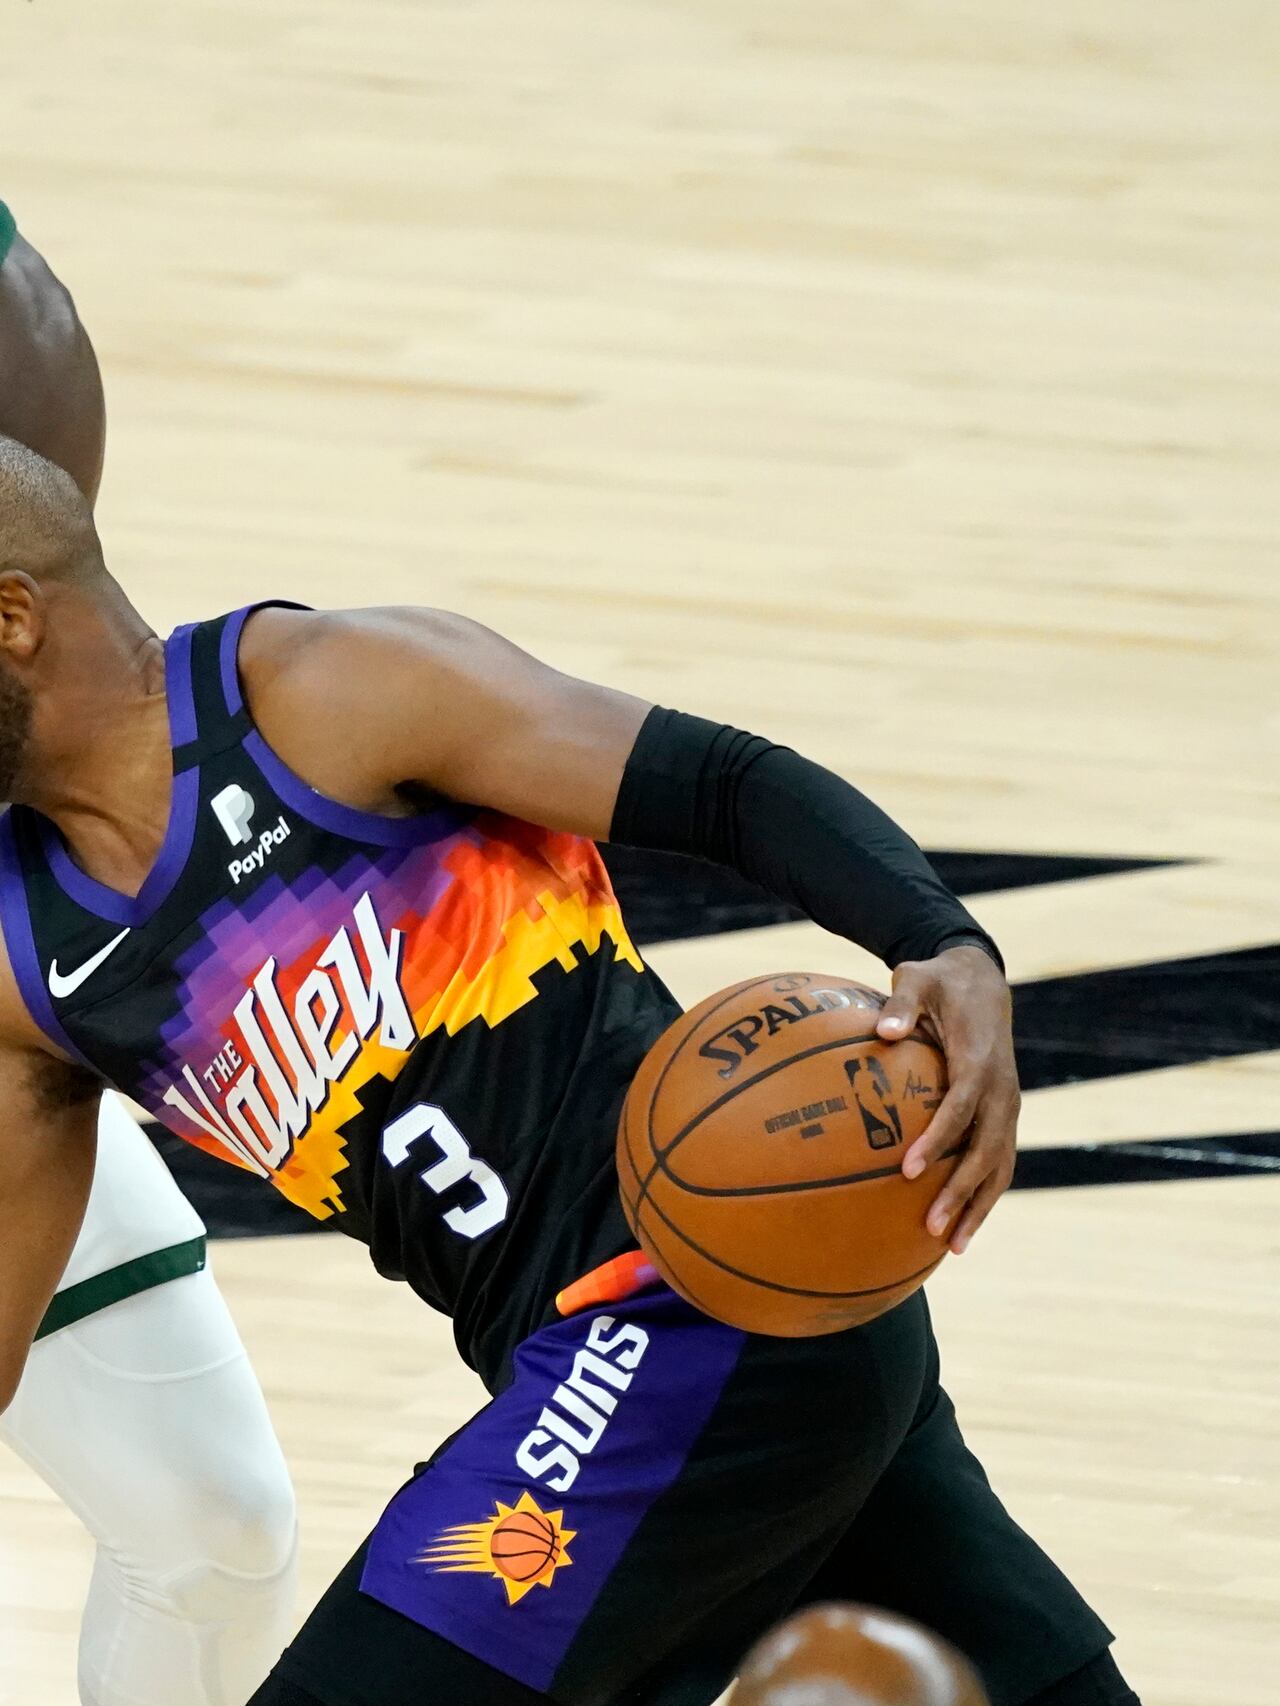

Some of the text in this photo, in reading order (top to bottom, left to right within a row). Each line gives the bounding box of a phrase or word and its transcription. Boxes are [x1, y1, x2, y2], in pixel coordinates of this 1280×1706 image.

[228, 815, 291, 885] PayPal
[162, 890, 420, 1181] Valley
[202, 1040, 244, 1094] THE
[379, 1101, 510, 1240] 3
